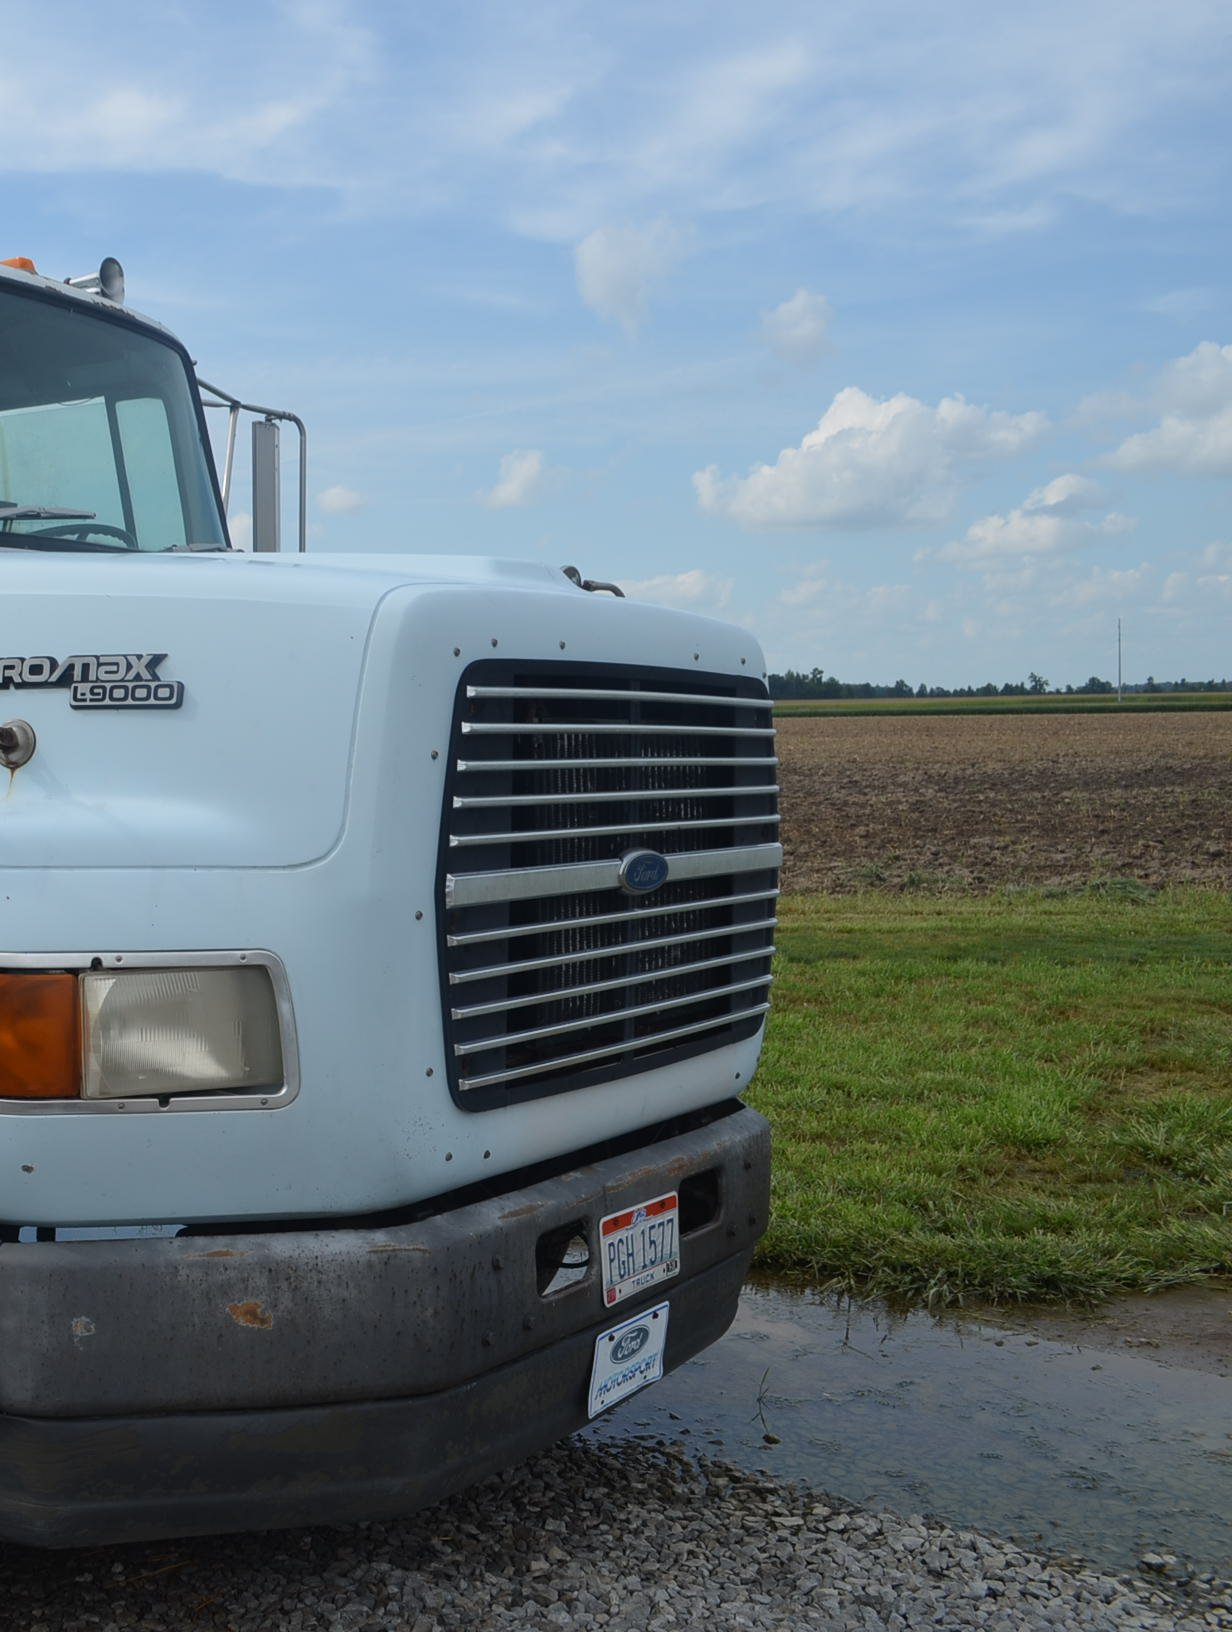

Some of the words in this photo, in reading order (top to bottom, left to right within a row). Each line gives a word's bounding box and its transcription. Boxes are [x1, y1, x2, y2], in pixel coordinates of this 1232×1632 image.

[72, 683, 176, 703] L-9000
[608, 1232, 636, 1285] PGH
[640, 1217, 675, 1270] 1577
[632, 1270, 656, 1289] TRUCK
[616, 1331, 645, 1360] Ford
